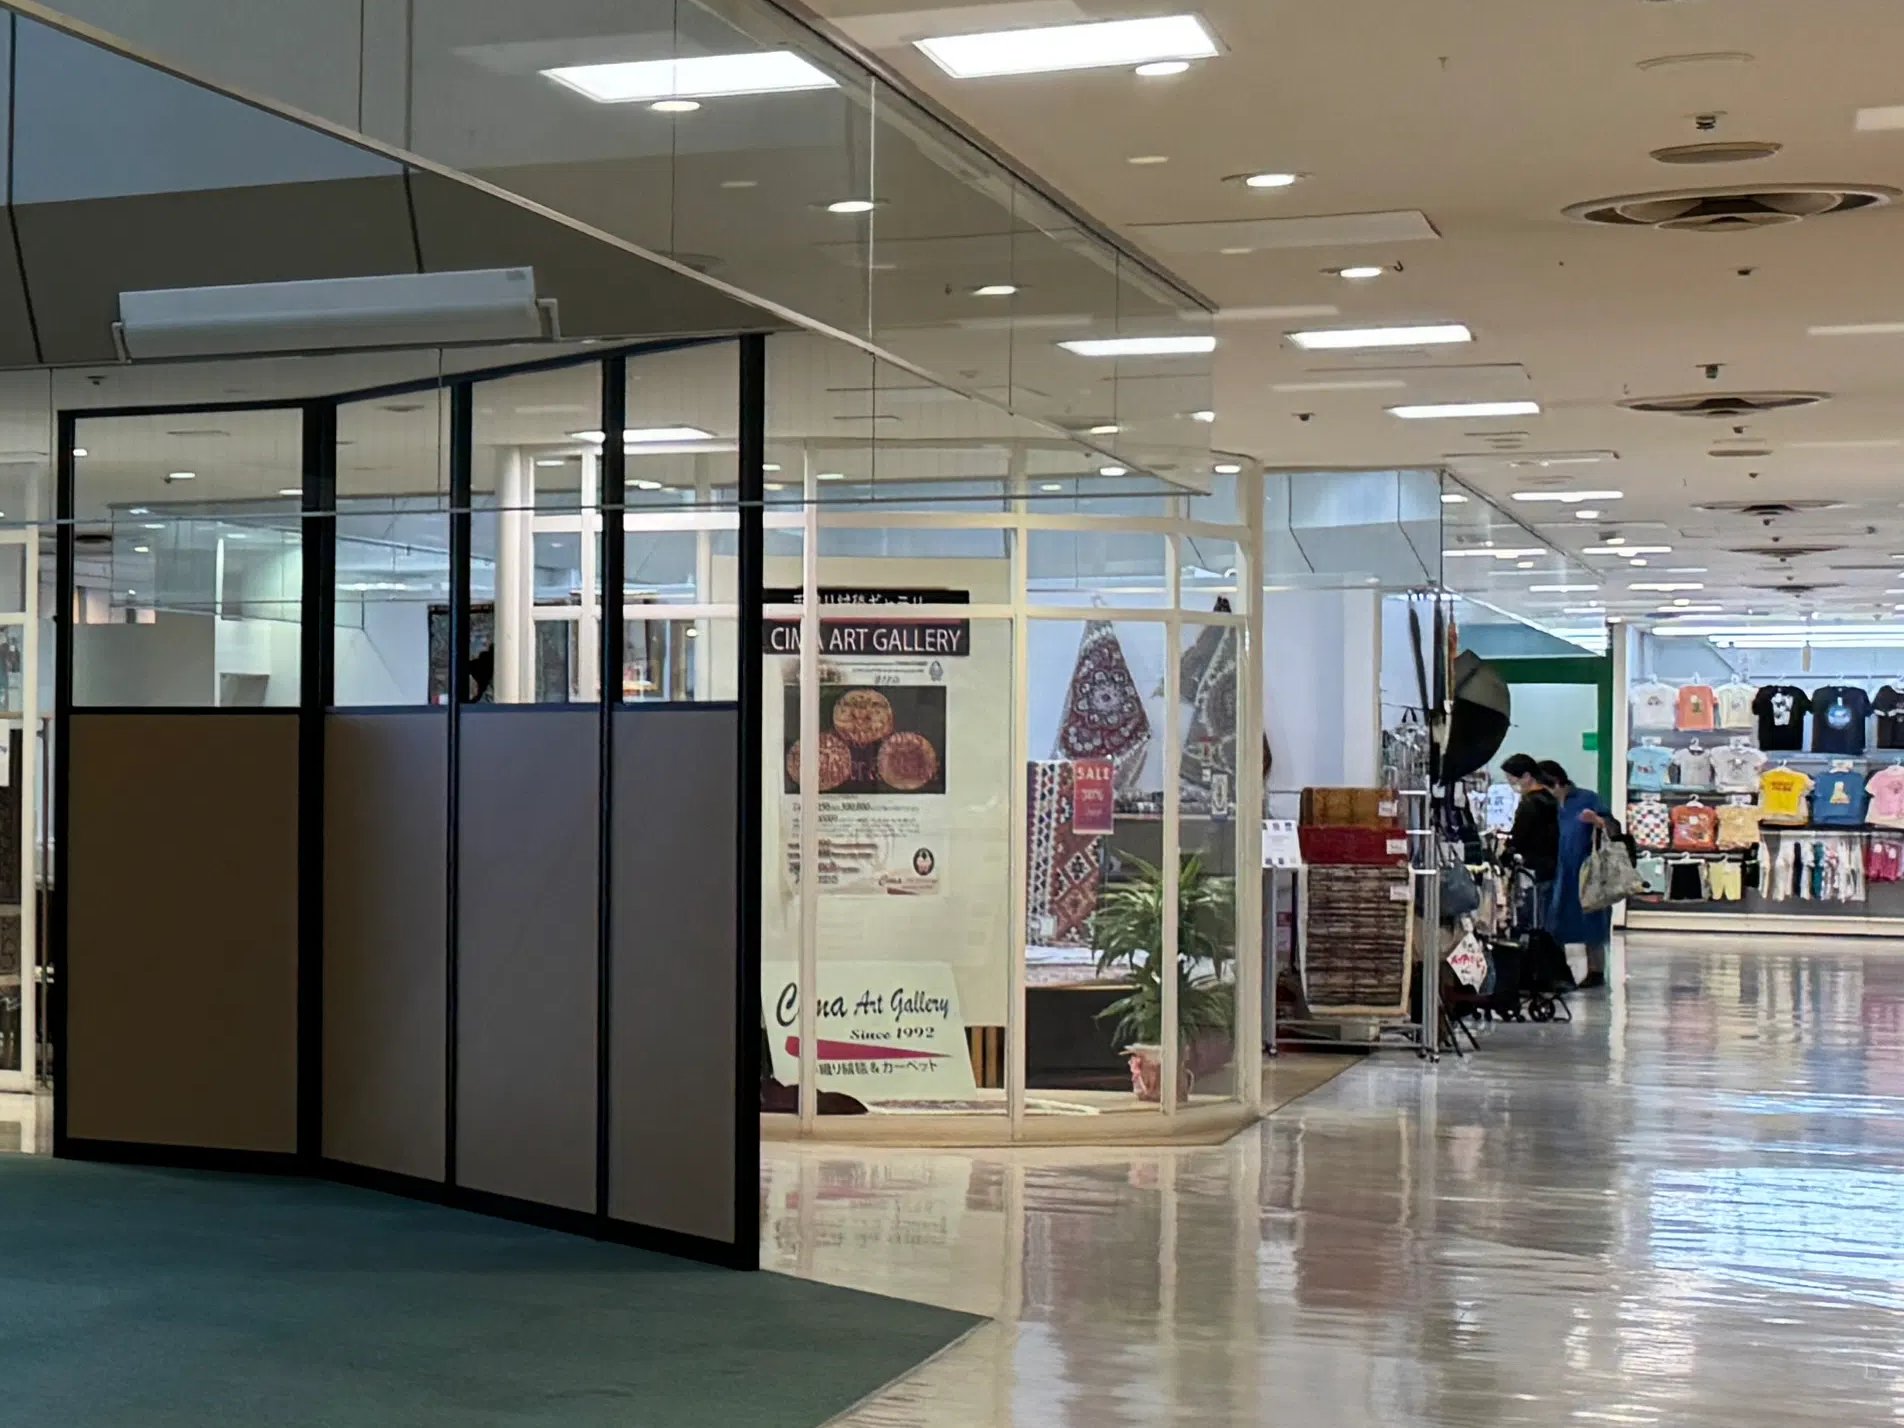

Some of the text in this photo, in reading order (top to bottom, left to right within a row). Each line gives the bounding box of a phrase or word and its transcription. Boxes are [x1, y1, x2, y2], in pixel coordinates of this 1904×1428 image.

[770, 627, 962, 652] CI ART GALLERY
[776, 982, 950, 1027] Cma Art Gallery
[849, 1027, 936, 1041] Since 1992
